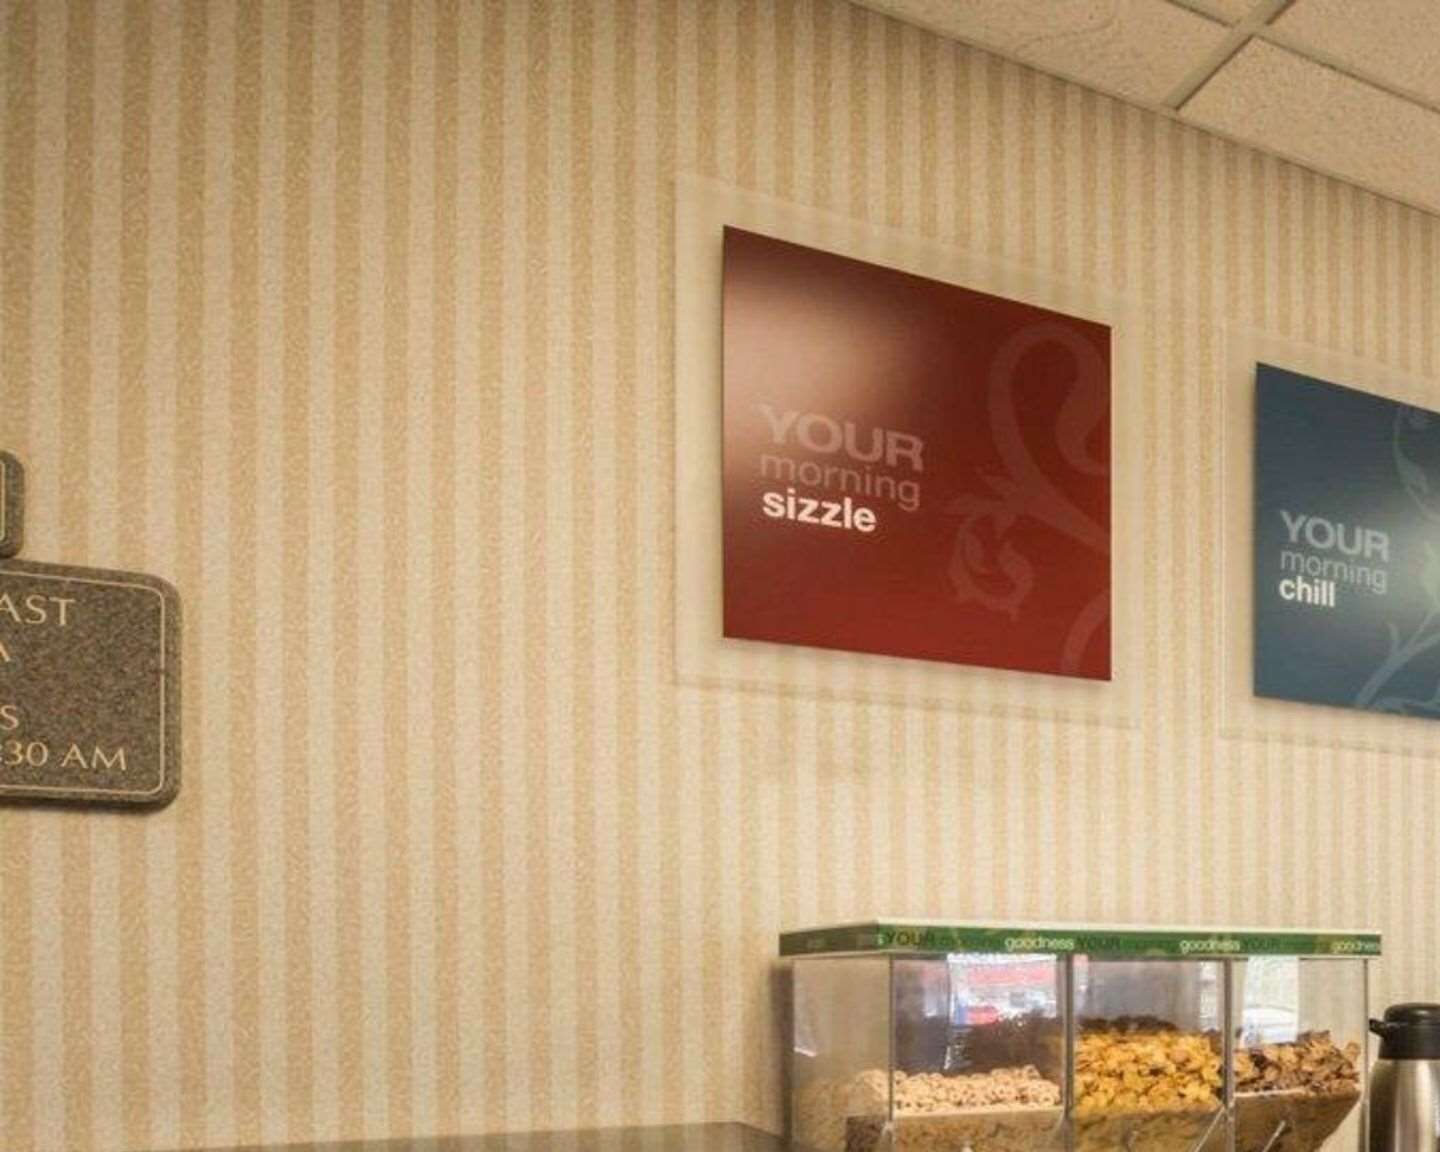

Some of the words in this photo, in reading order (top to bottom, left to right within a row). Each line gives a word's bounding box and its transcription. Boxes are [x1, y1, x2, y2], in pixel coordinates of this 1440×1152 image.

[757, 403, 924, 472] YOUR
[760, 452, 921, 512] morning
[761, 487, 877, 532] sizzle
[1280, 508, 1389, 563] YOUR
[1278, 575, 1336, 608] chill
[1280, 550, 1388, 595] morning
[60, 743, 127, 771] AM
[1004, 936, 1075, 952] goodness
